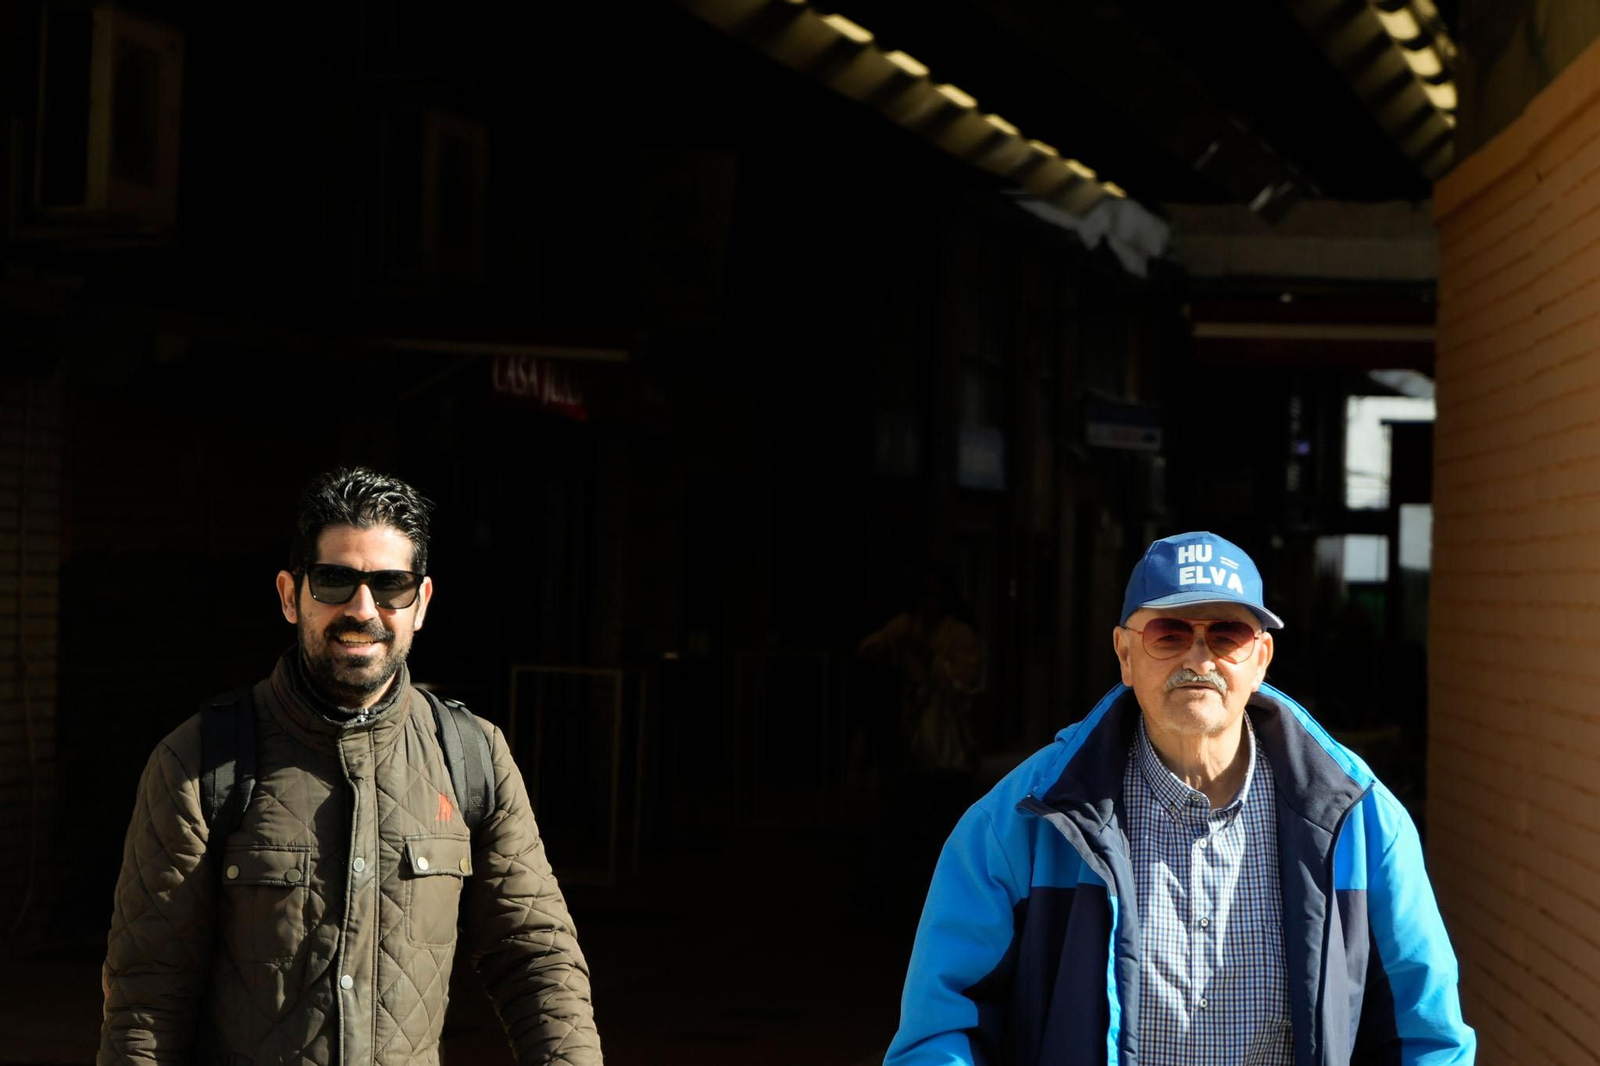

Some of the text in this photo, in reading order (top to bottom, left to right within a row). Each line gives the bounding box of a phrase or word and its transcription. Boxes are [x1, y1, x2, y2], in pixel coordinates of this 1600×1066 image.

[492, 355, 539, 397] CASA
[1178, 544, 1212, 564] HU
[1179, 565, 1243, 594] ELVA
